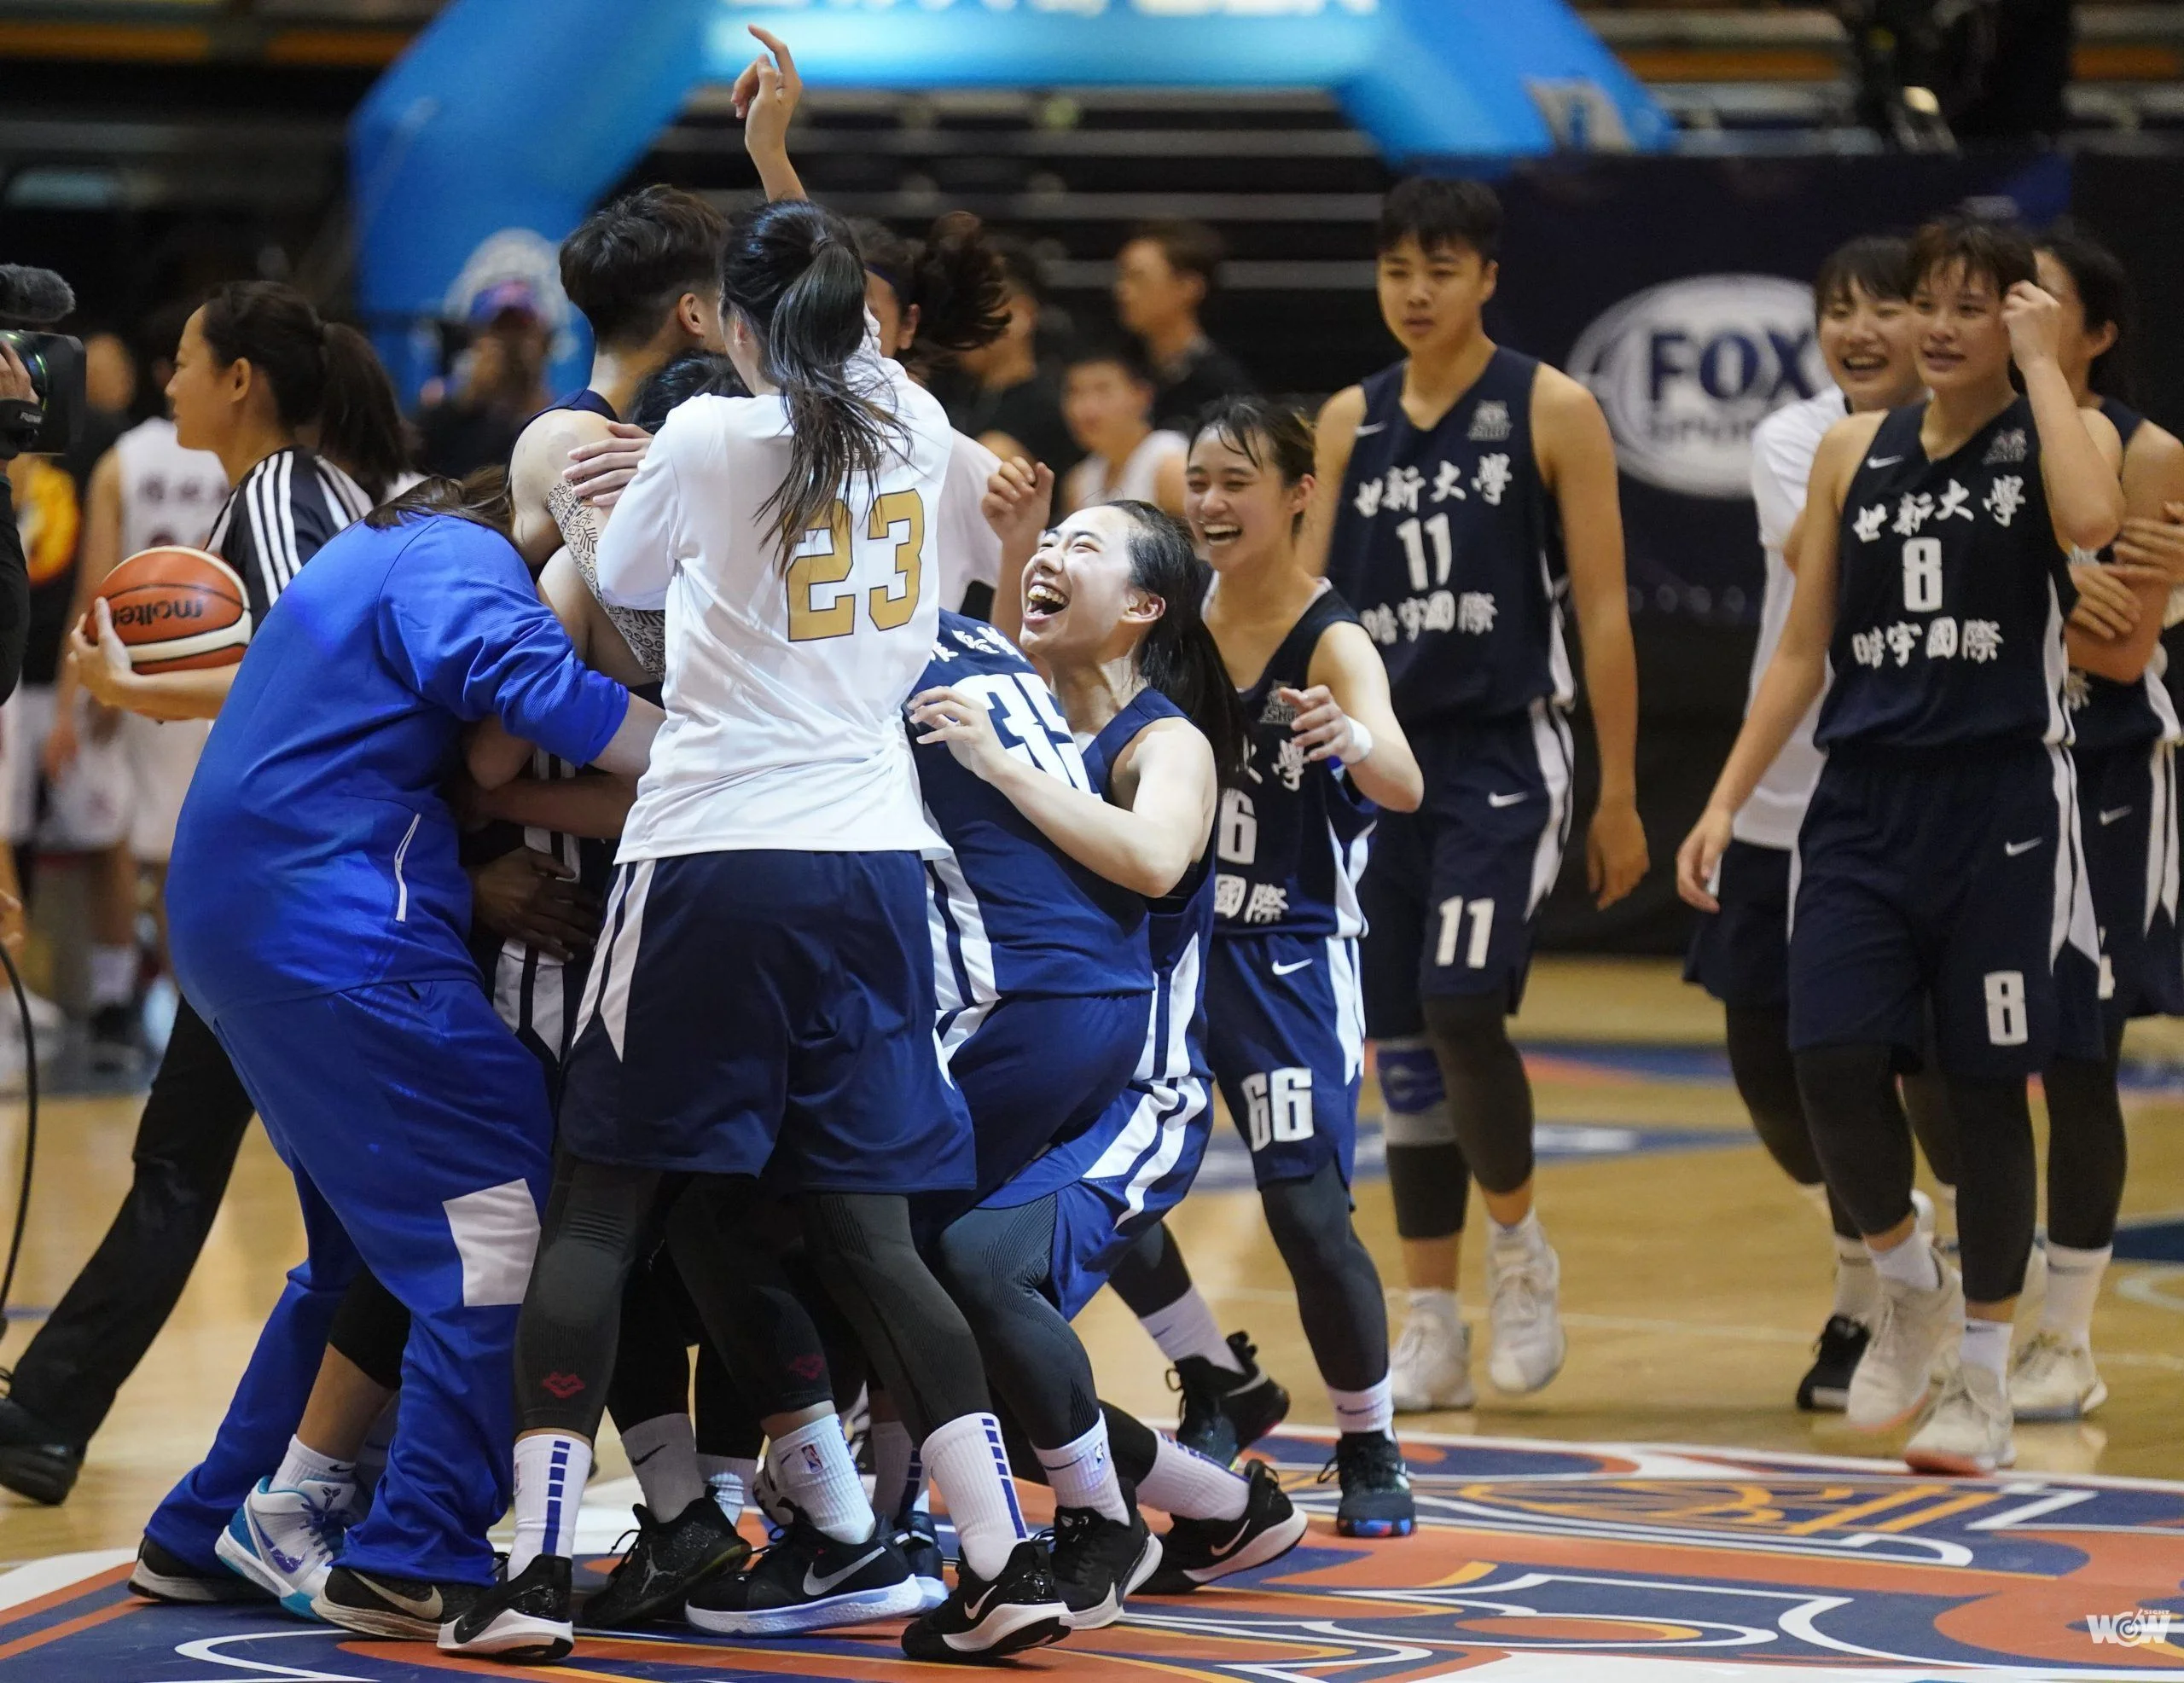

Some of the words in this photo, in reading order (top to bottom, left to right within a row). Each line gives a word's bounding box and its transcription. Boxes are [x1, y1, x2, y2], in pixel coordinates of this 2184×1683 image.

[1650, 329, 1815, 403] FOX
[782, 488, 925, 642] 23
[1396, 513, 1451, 591] 11
[1902, 537, 1943, 612] 8
[1435, 895, 1495, 969] 11
[1984, 969, 2029, 1046] 8
[1240, 1066, 1315, 1152] 66
